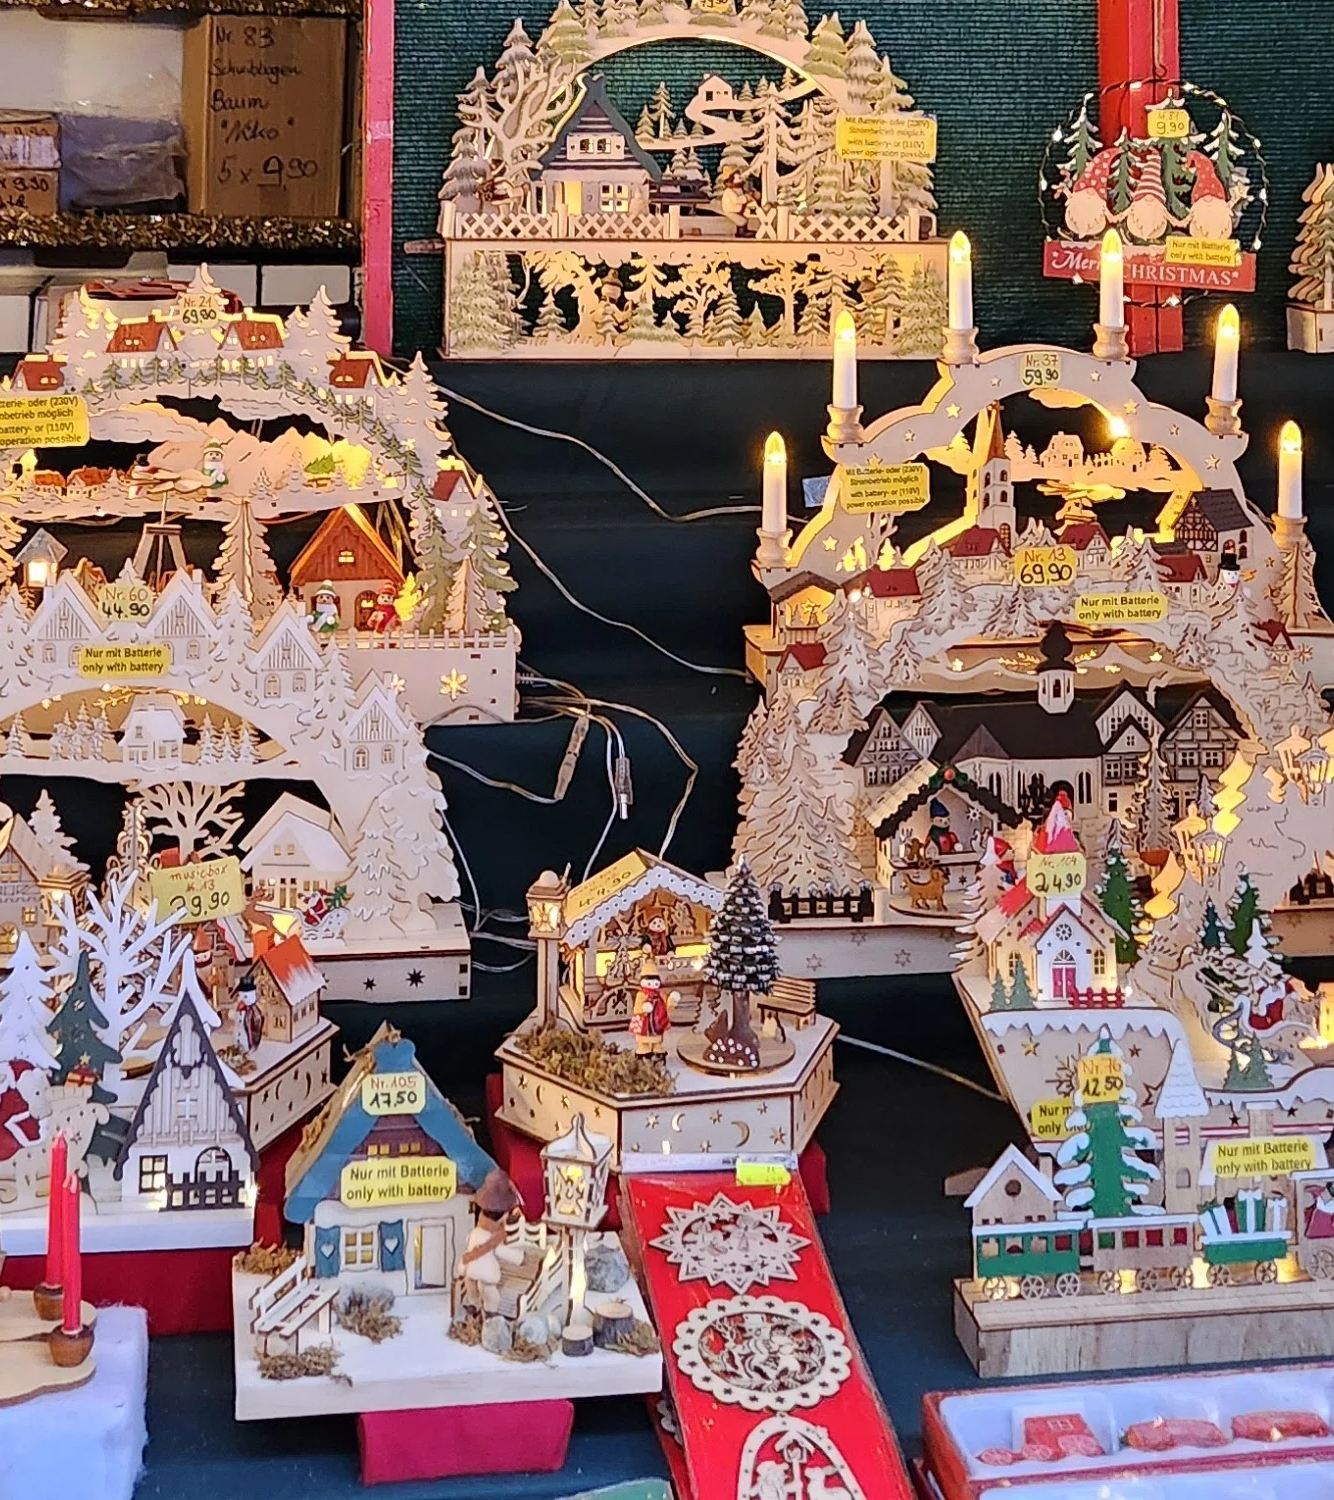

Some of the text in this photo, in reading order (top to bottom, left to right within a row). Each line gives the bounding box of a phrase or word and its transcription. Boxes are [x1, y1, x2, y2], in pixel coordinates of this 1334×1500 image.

[1156, 122, 1185, 136] 9.90
[1123, 263, 1233, 286] HRISTMAS
[1042, 355, 1058, 366] 37
[1023, 369, 1058, 385] 59.90
[1025, 550, 1066, 563] Nr. 13
[107, 588, 147, 601] Nr. 60
[1081, 594, 1159, 607] Nur mit Batterie
[102, 602, 149, 619] 44.90
[1079, 609, 1161, 623] only with battery
[86, 647, 162, 658] Nur mit Batterie
[83, 661, 164, 674] only with battery
[170, 864, 228, 882] musicbox
[1034, 872, 1082, 892] 24.90
[370, 1077, 417, 1089] Nr. 105
[1082, 1076, 1123, 1098] 12.50
[1218, 1140, 1309, 1157] Nur mit Batterie
[350, 1165, 450, 1180] Nur mit Batterie
[1215, 1158, 1311, 1178] only with battery
[347, 1185, 452, 1203] only with battery
